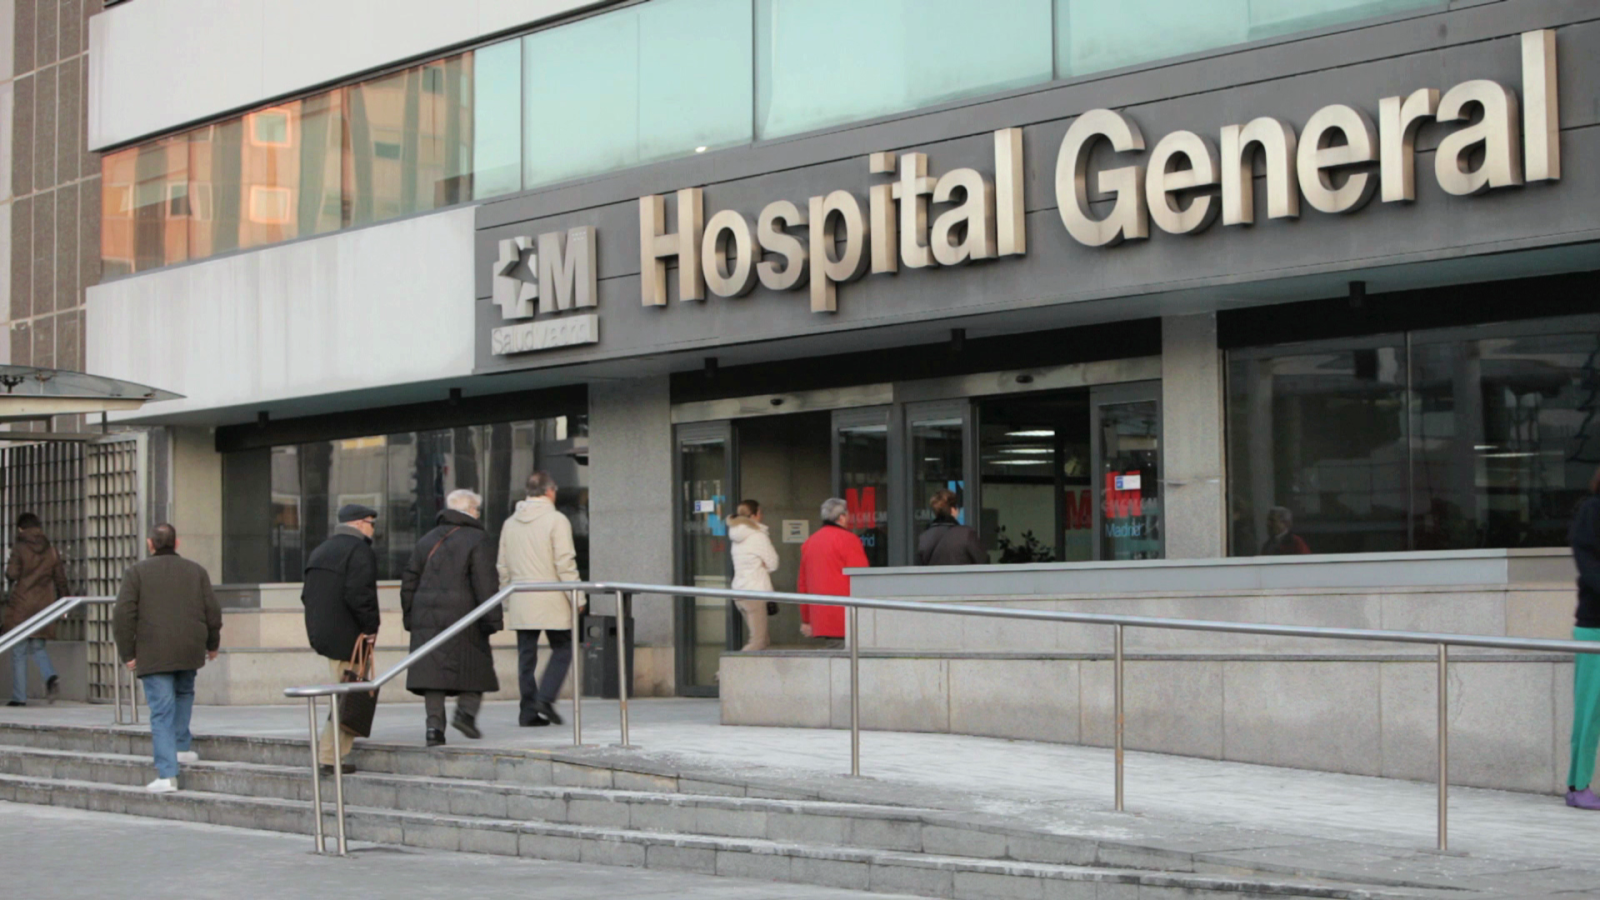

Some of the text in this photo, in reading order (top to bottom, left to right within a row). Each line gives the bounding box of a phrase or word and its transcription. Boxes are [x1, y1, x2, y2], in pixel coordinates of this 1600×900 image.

[639, 28, 1560, 312] Hospital General
[538, 225, 598, 314] M
[845, 486, 876, 529] M
[1066, 489, 1093, 530] M
[1105, 522, 1141, 538] Madrid
